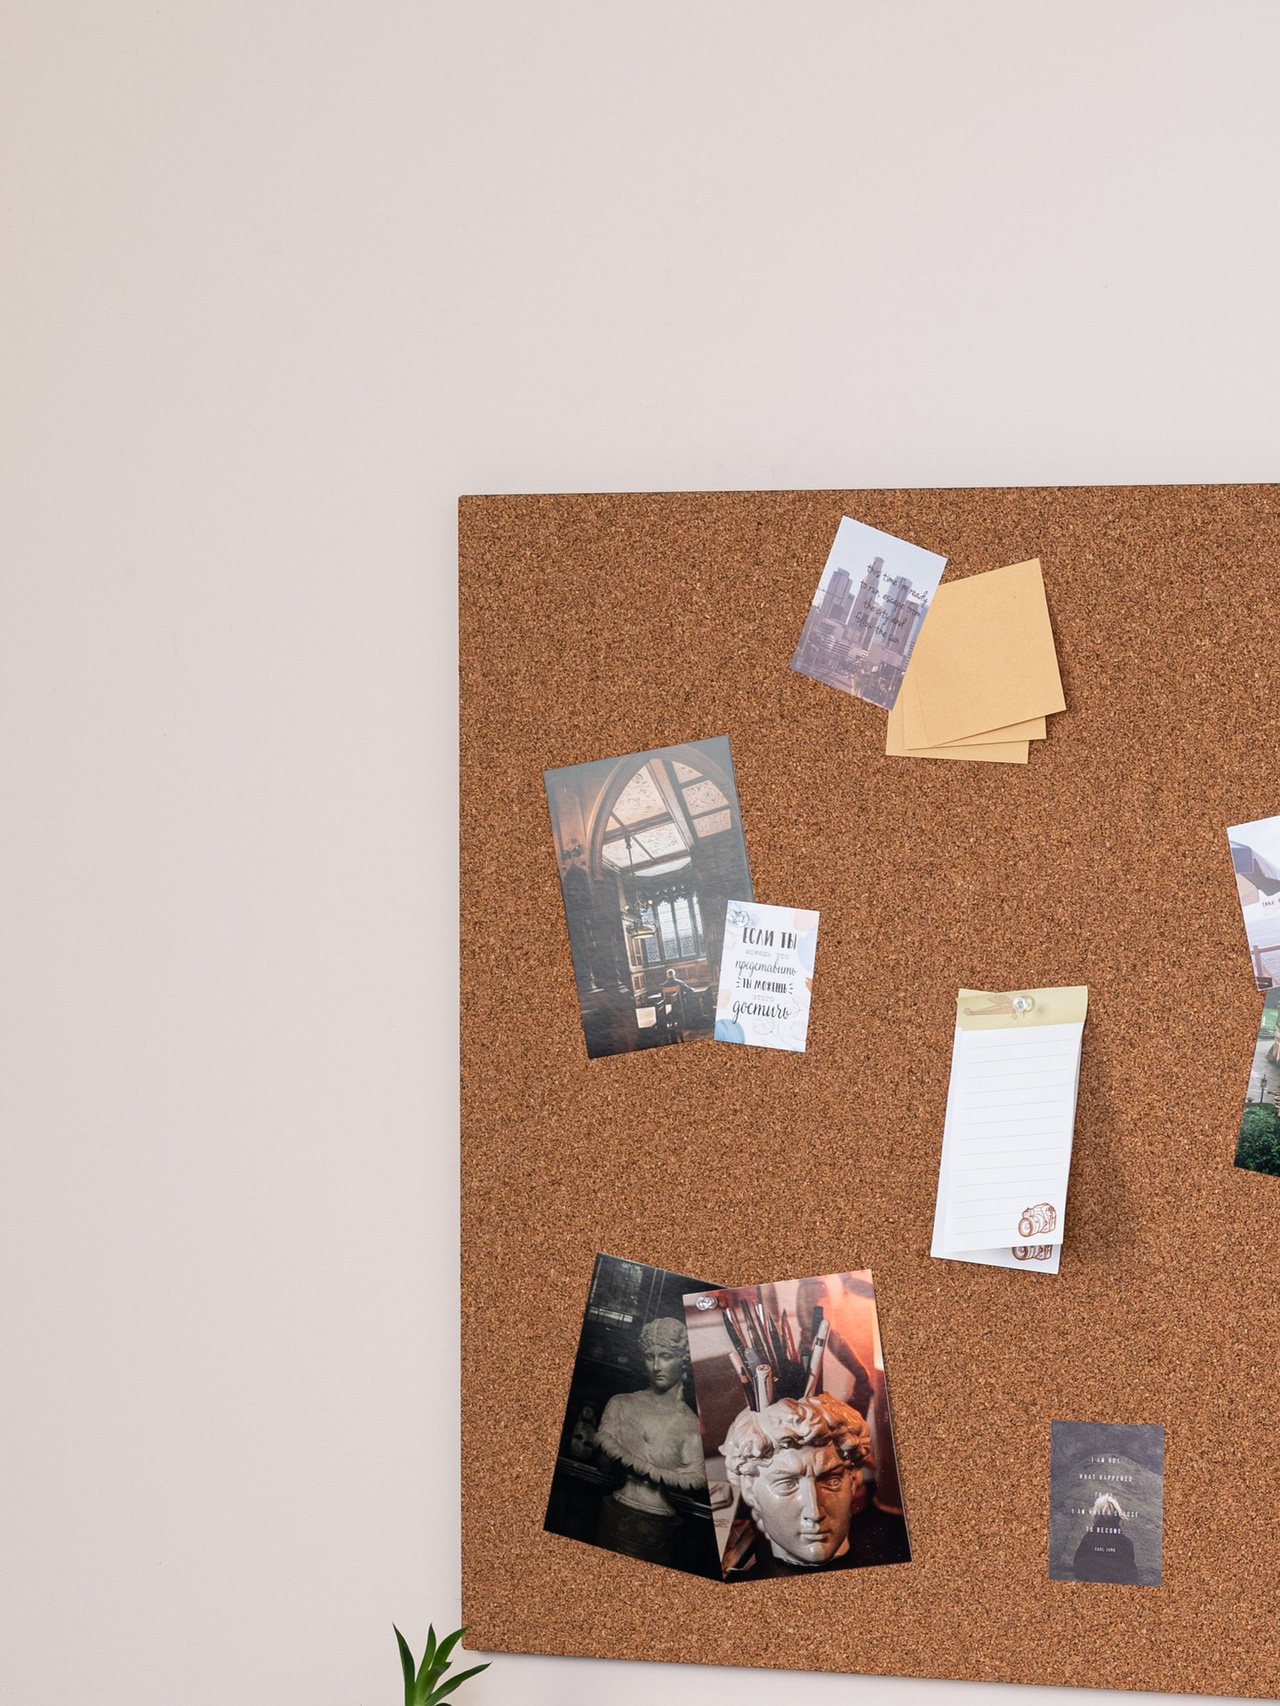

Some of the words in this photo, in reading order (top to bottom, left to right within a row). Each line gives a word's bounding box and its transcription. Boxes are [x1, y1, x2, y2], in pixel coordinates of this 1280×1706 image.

[742, 927, 774, 947] ЕСЛИ
[780, 931, 797, 950] ТЫ
[735, 957, 797, 977] представить
[732, 1000, 790, 1025] достичь
